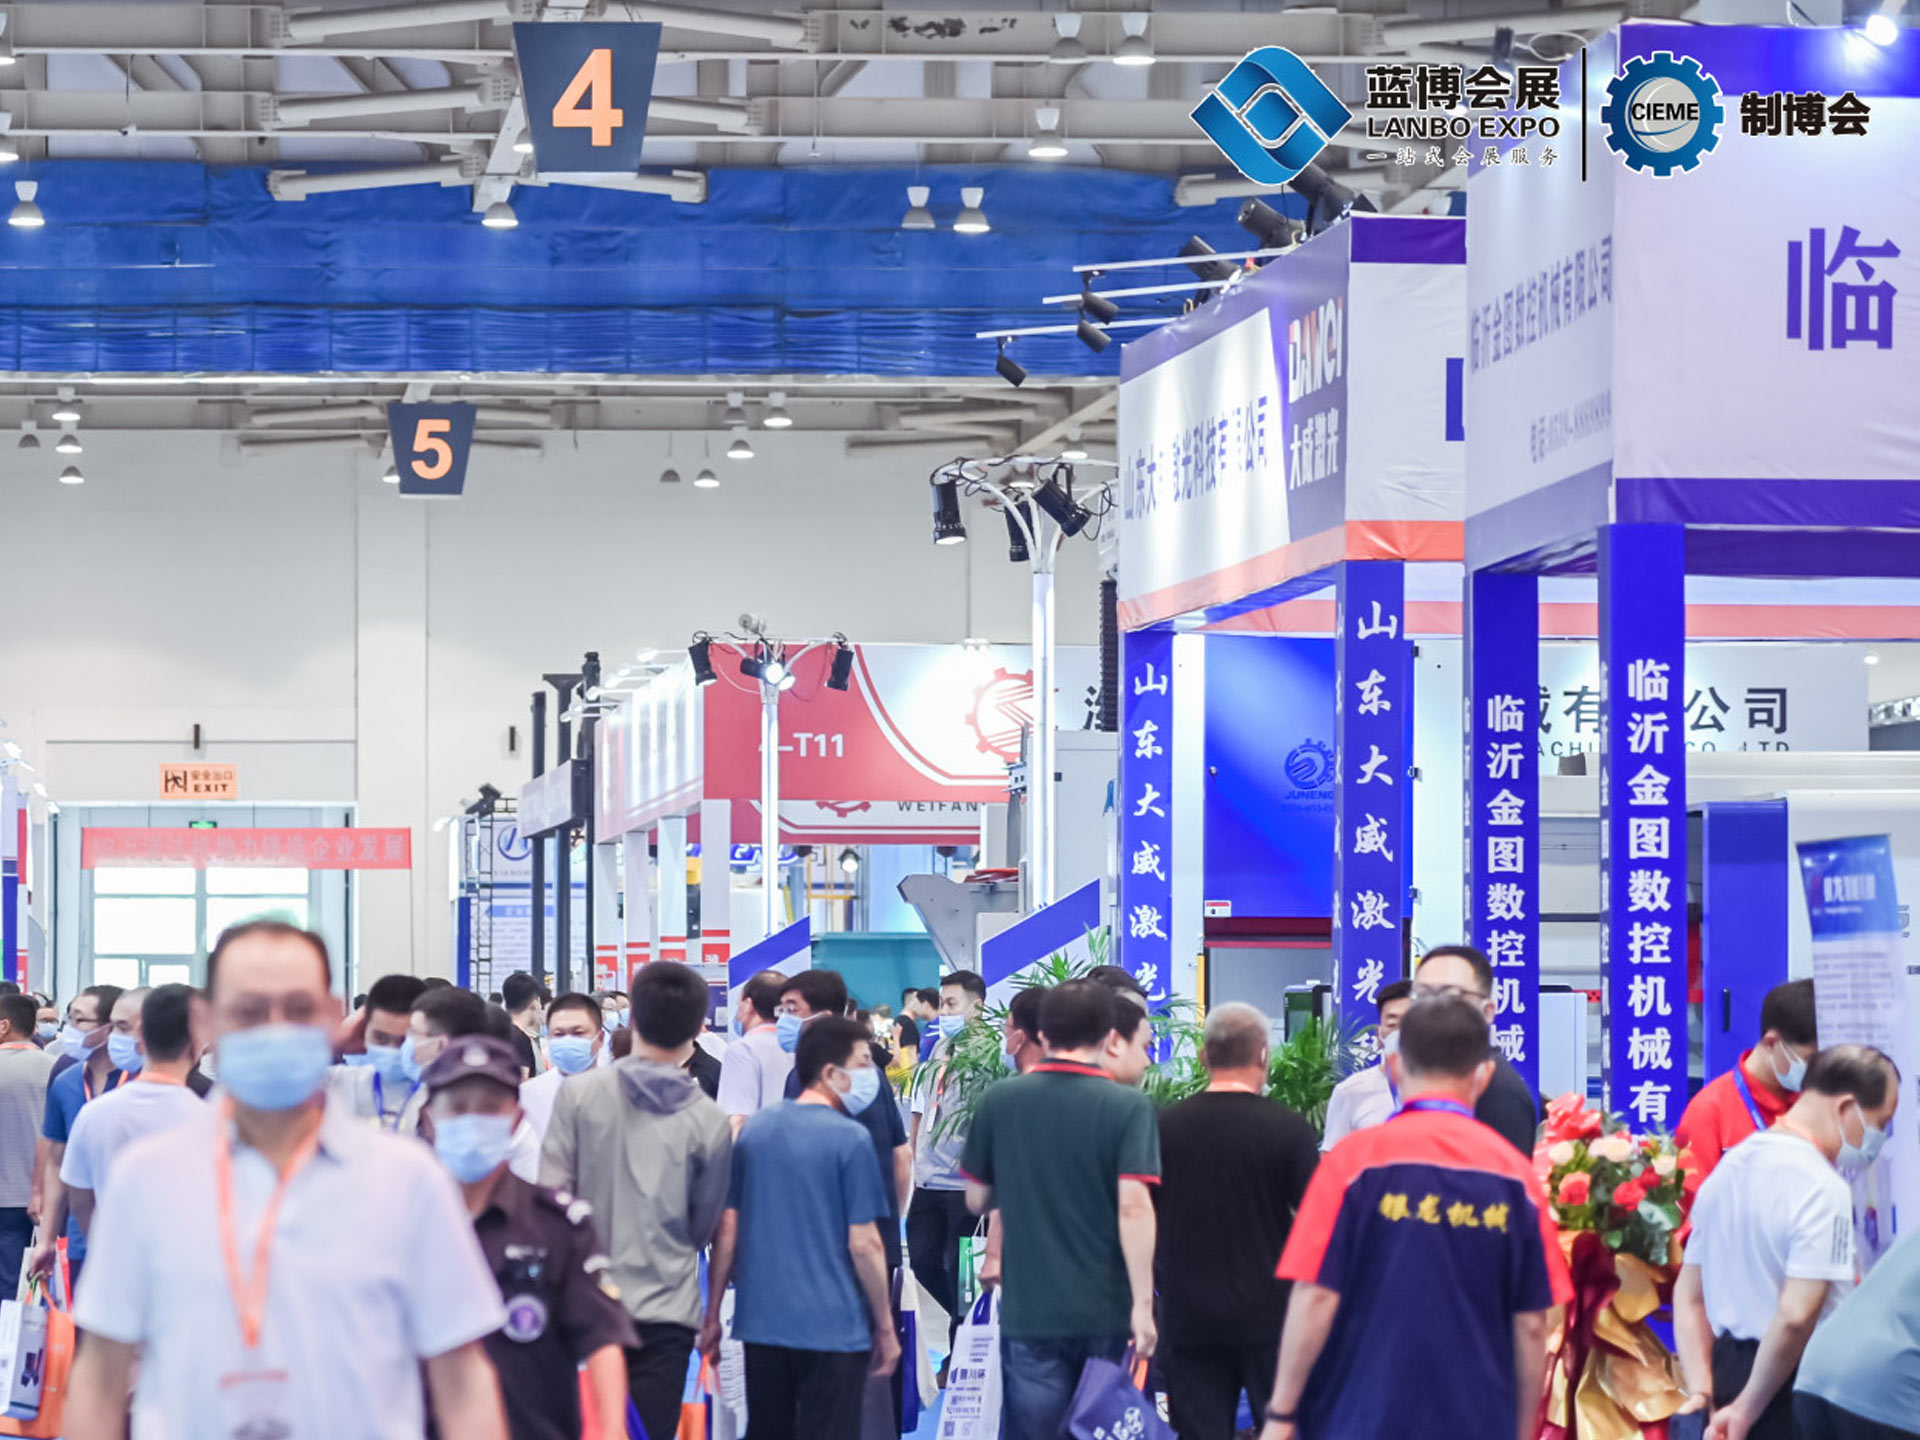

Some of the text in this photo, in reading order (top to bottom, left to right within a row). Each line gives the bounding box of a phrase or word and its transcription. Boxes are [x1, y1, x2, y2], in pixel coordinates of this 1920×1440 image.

[552, 48, 623, 146] 4
[1787, 225, 1901, 350] 临
[411, 418, 453, 480] 5
[194, 784, 228, 793] EXIT
[1129, 663, 1168, 1045] 山东大威激光
[1627, 659, 1674, 1138] 临沂金图数控机械有
